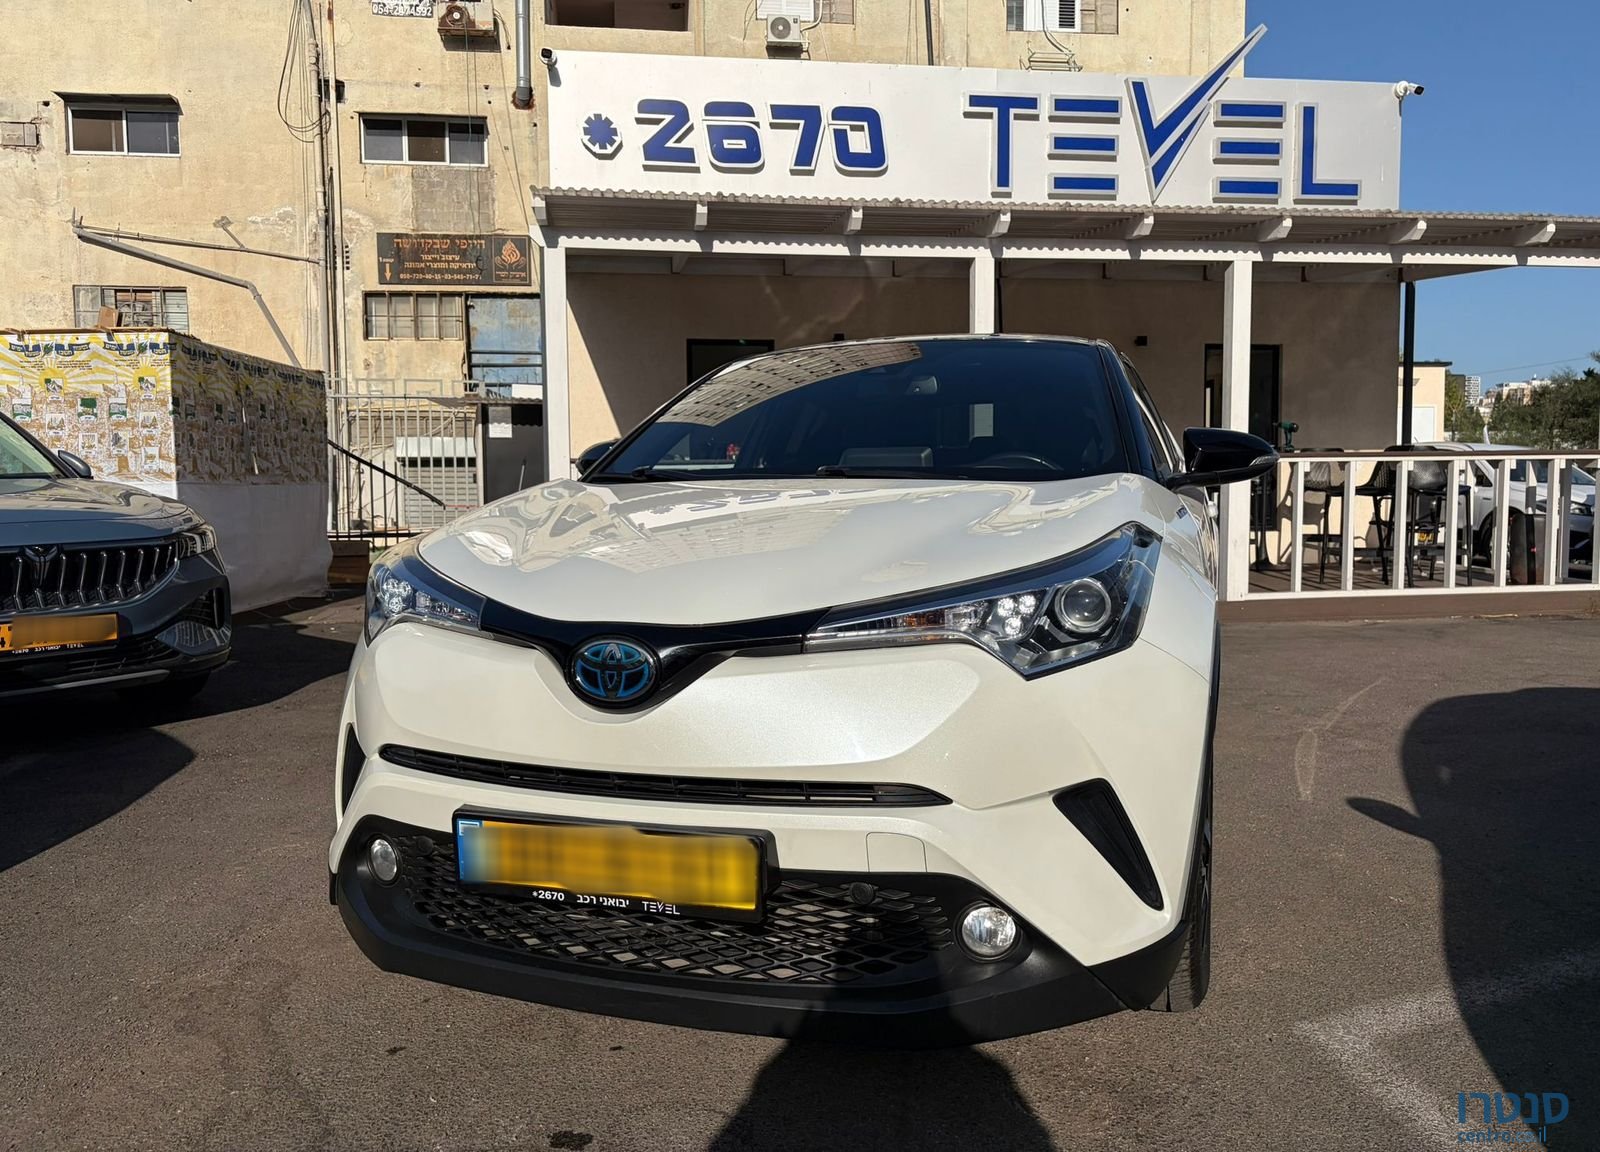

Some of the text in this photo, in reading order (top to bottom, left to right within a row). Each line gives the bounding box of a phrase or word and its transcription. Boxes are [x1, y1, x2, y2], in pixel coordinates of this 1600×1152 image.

[964, 24, 1361, 205] TEVEL
[576, 893, 630, 908] יבואני רכב
[642, 899, 681, 916] TEVEL
